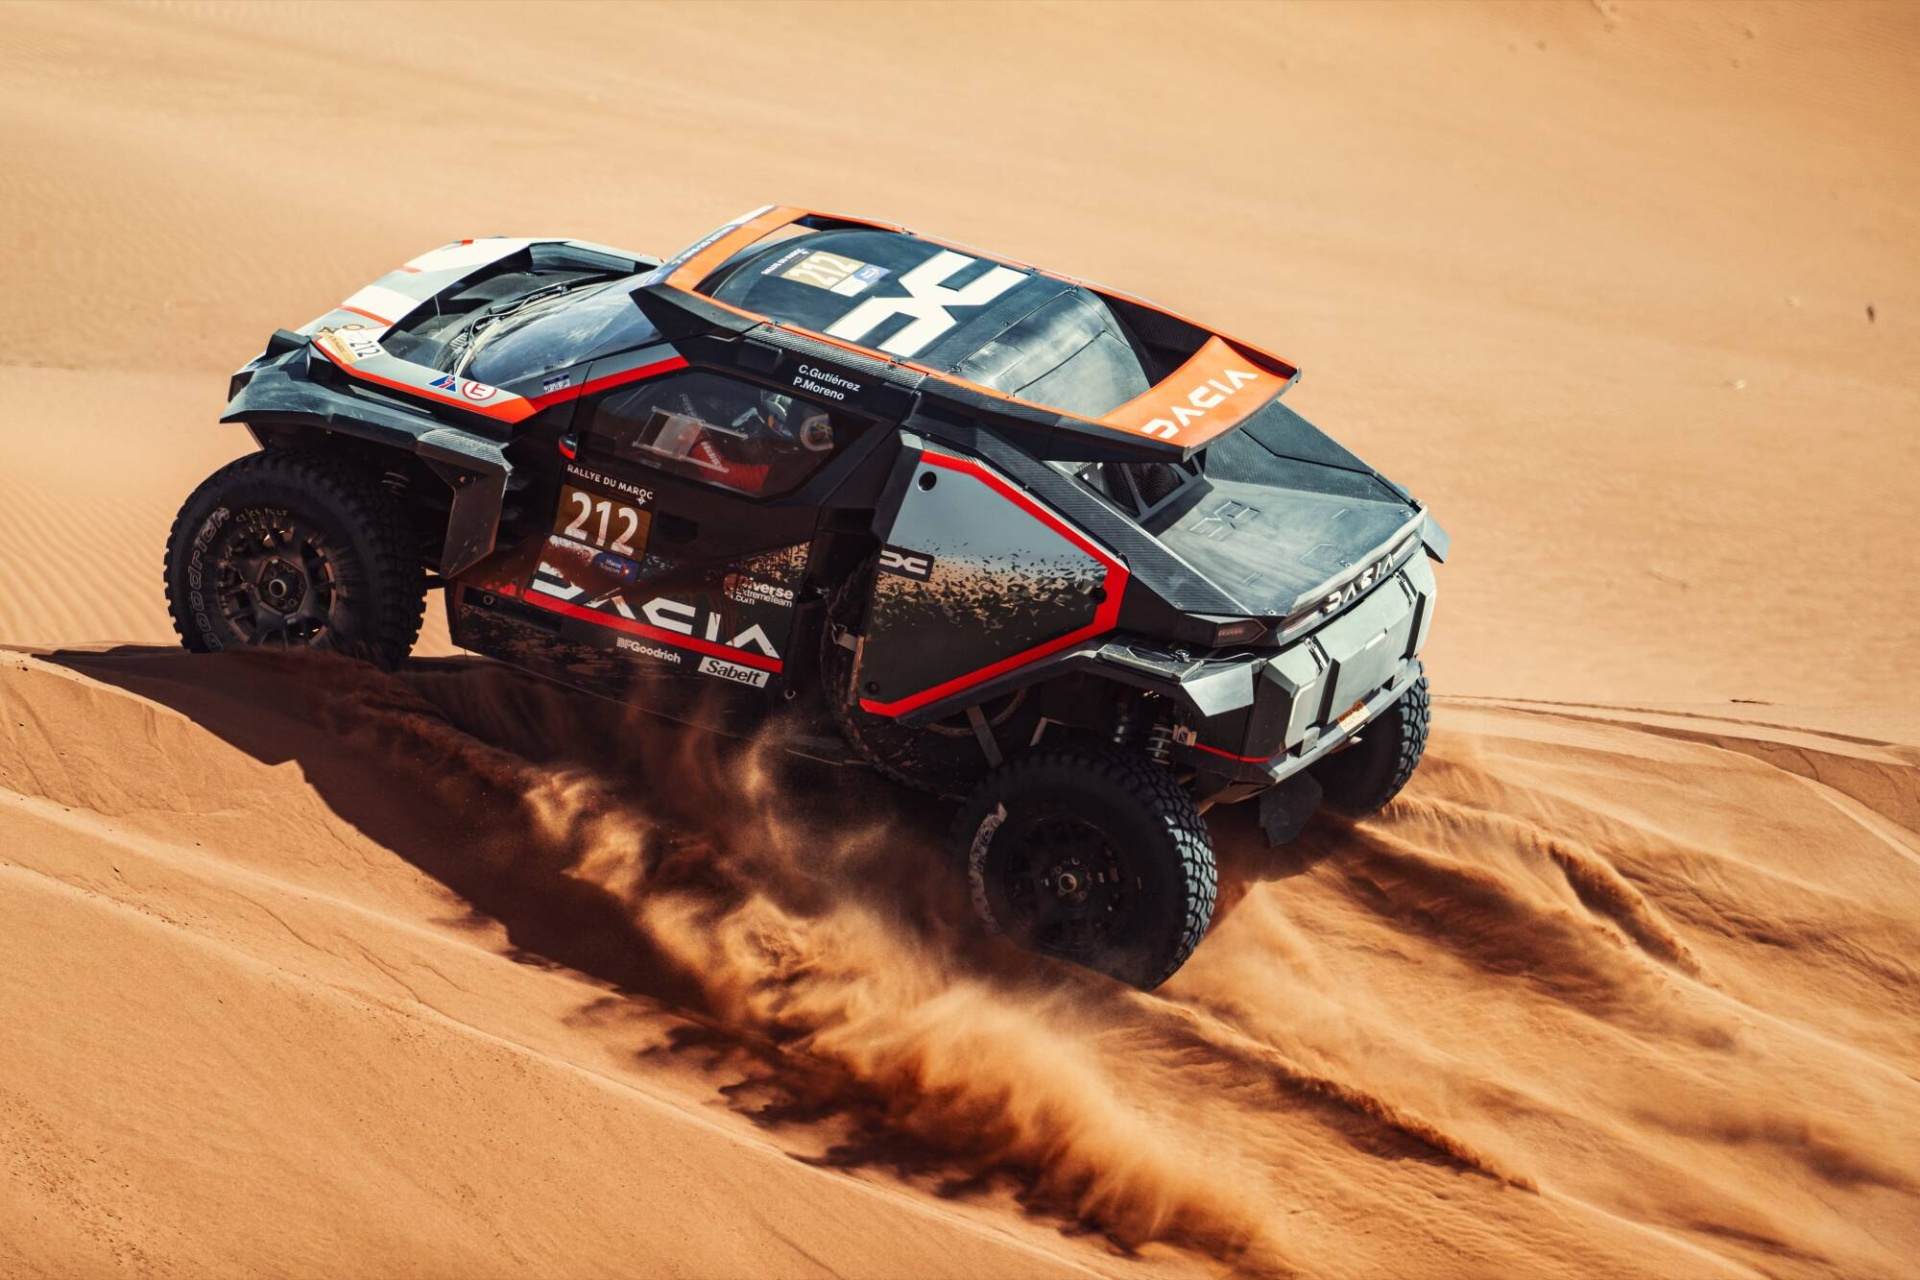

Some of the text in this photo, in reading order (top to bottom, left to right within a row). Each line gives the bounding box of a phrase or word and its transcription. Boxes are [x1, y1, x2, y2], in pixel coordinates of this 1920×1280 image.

[788, 252, 861, 289] 212
[349, 340, 381, 357] 212
[793, 378, 845, 401] P.Moreno
[798, 365, 860, 392] C.Gutiérrez
[1142, 368, 1259, 439] DACIA
[567, 464, 653, 499] RALLYE DU MAROC
[564, 492, 639, 556] 212
[741, 576, 794, 599] iverse
[1324, 553, 1394, 613] DACIA
[531, 561, 780, 659] DACIA
[616, 637, 682, 663] BFGoodrich
[706, 660, 760, 685] Sabelt
